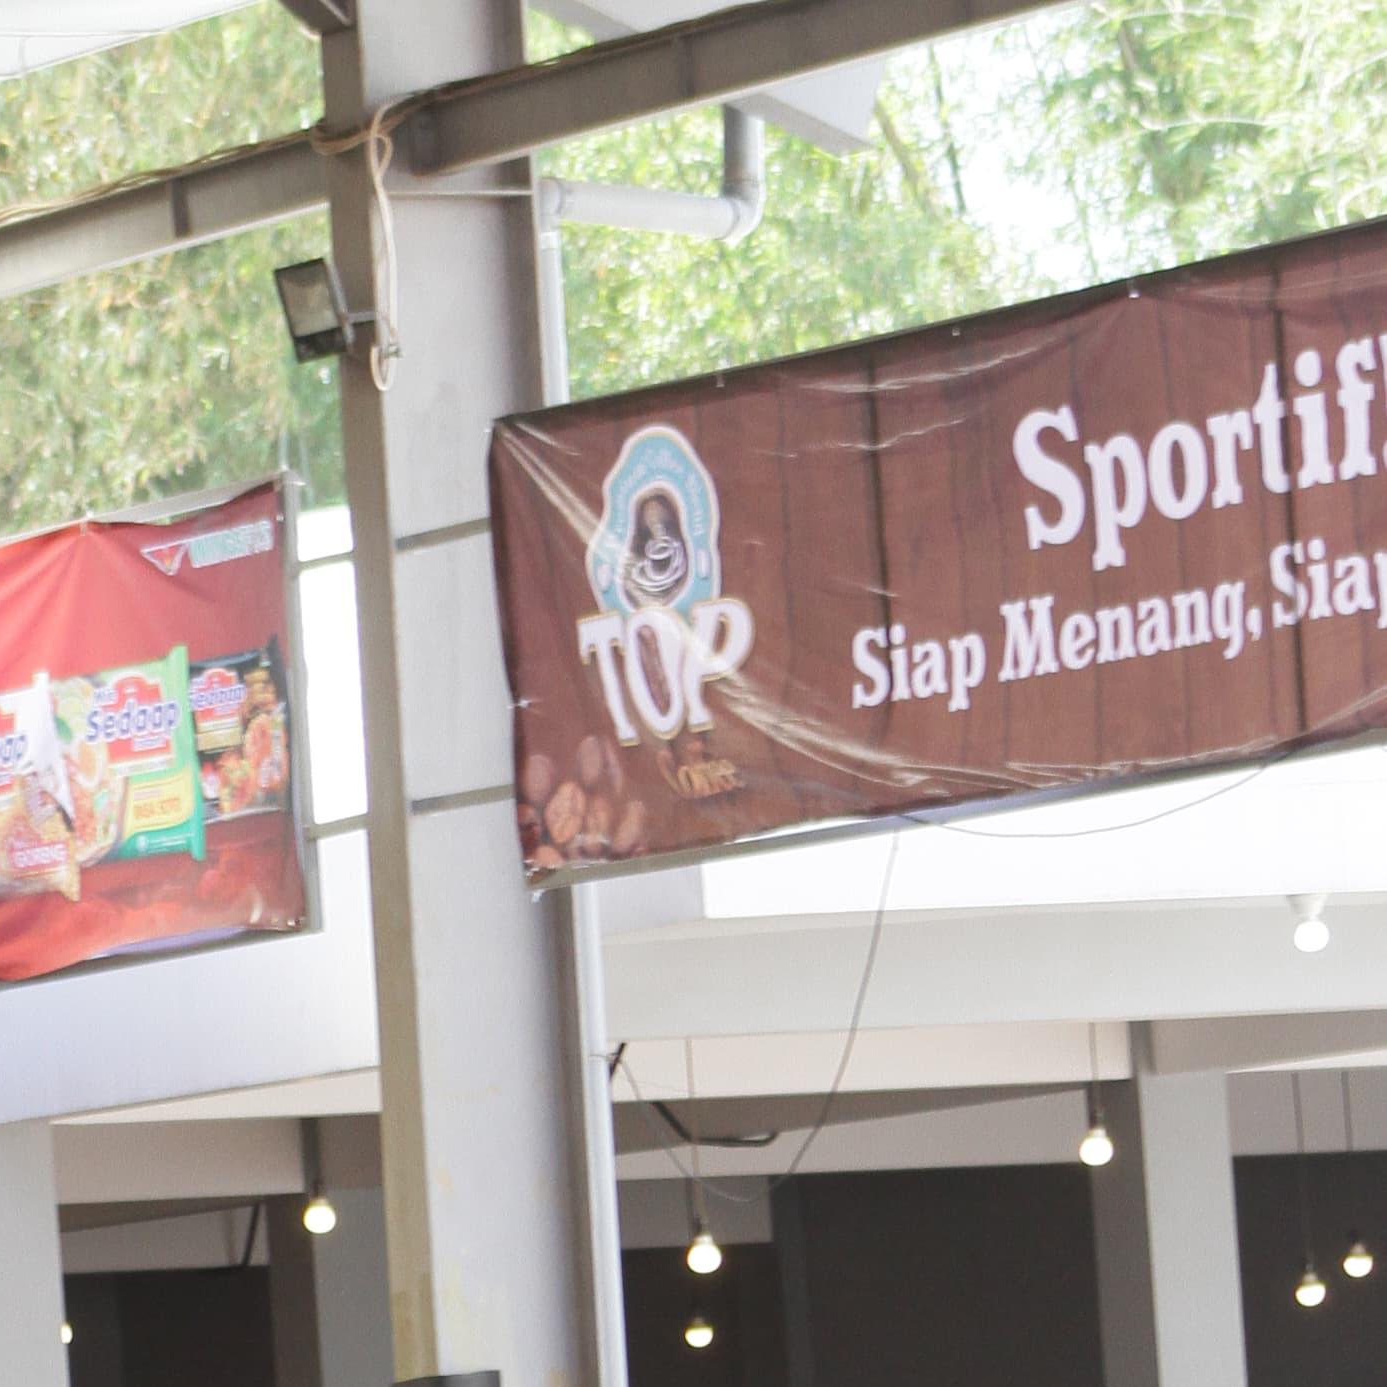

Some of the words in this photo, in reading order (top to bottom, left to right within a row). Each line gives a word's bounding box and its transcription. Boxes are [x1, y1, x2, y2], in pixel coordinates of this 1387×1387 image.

[1013, 334, 1387, 571] Sportif
[576, 598, 756, 747] TOP
[852, 622, 986, 712] Siap
[998, 594, 1262, 682] Menang,
